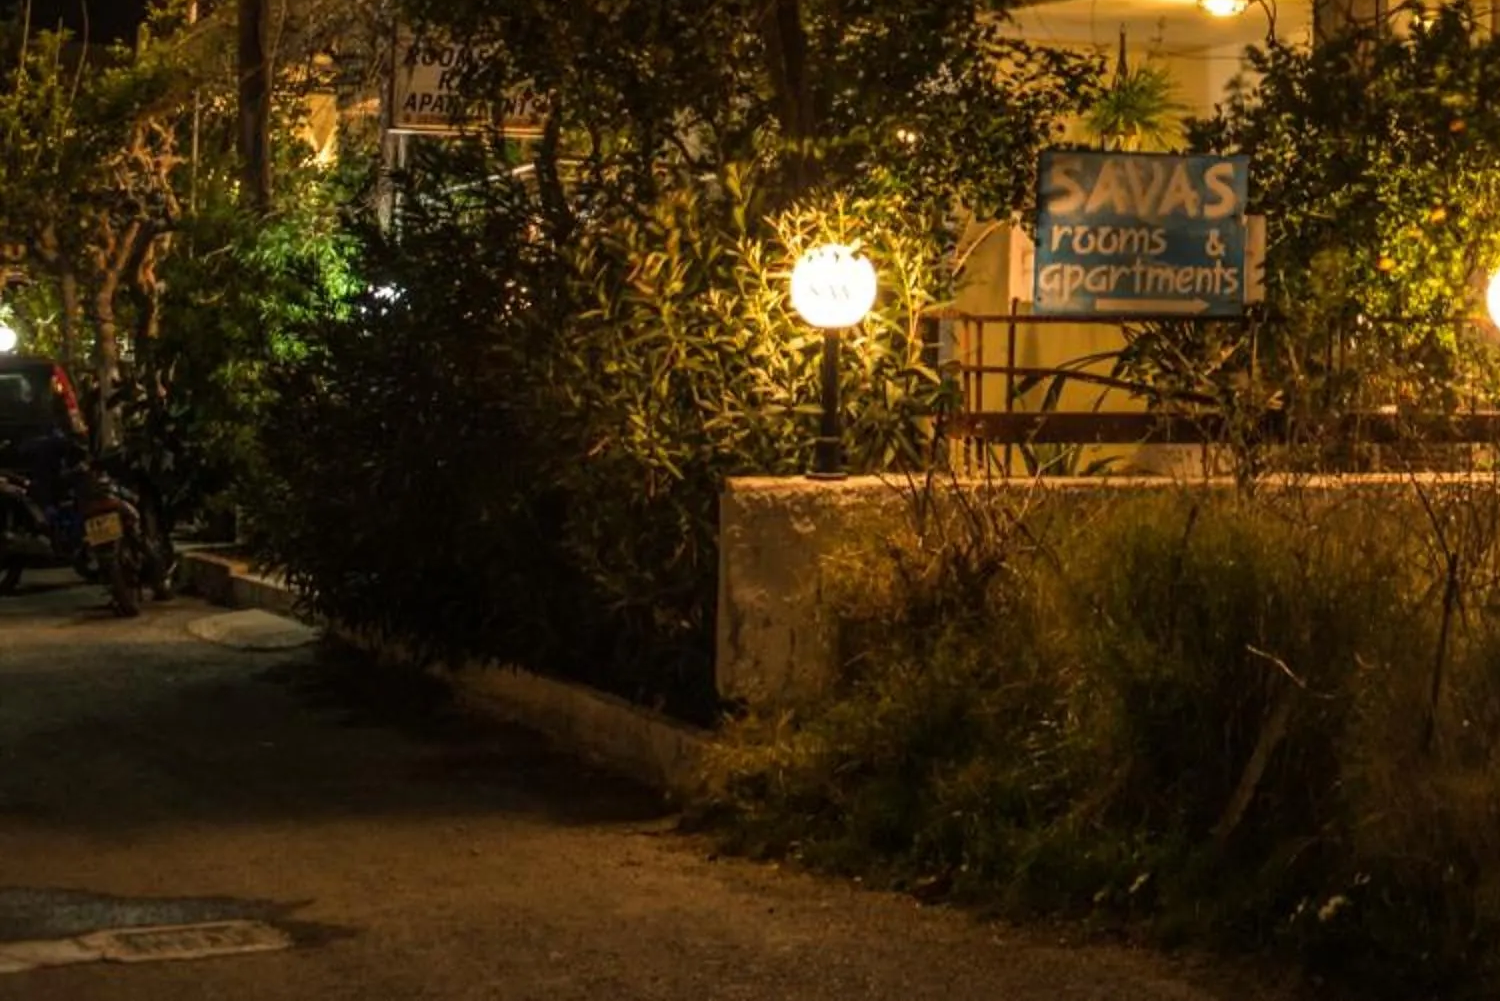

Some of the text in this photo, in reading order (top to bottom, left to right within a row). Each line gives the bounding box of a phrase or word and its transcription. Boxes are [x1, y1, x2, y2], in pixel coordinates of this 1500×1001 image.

[1047, 155, 1237, 219] SAVAS
[1051, 225, 1226, 257] rooms &
[1038, 259, 1239, 301] apartments
